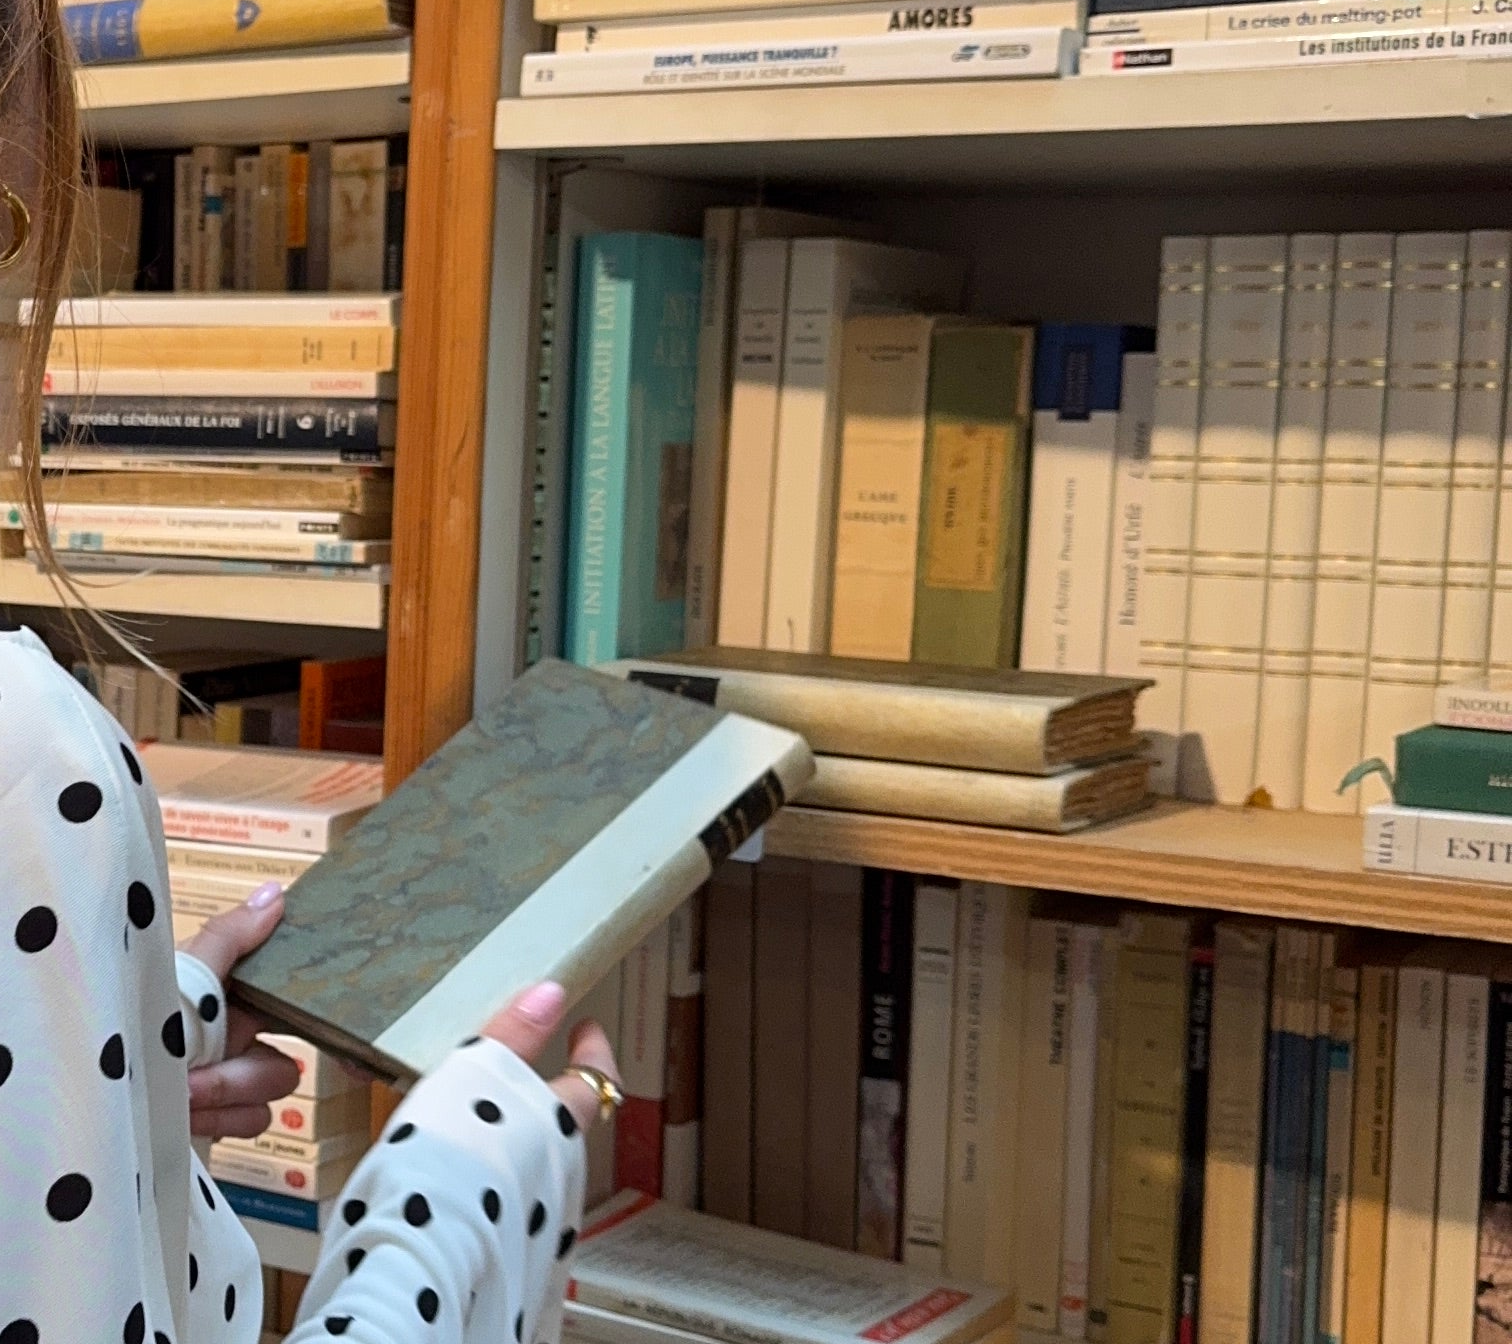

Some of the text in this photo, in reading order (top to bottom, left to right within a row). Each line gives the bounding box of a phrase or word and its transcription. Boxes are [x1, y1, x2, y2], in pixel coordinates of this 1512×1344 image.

[887, 5, 975, 33] AMORES
[1252, 10, 1318, 30] crise du
[1298, 29, 1466, 57] Les institutions de la
[121, 411, 184, 429] GÉNÉRAUX
[185, 415, 201, 428] DE
[202, 415, 217, 428] LA
[219, 414, 243, 429] FOI
[583, 339, 615, 616] INITIATION LA LANGUE
[871, 992, 897, 1061] ROME
